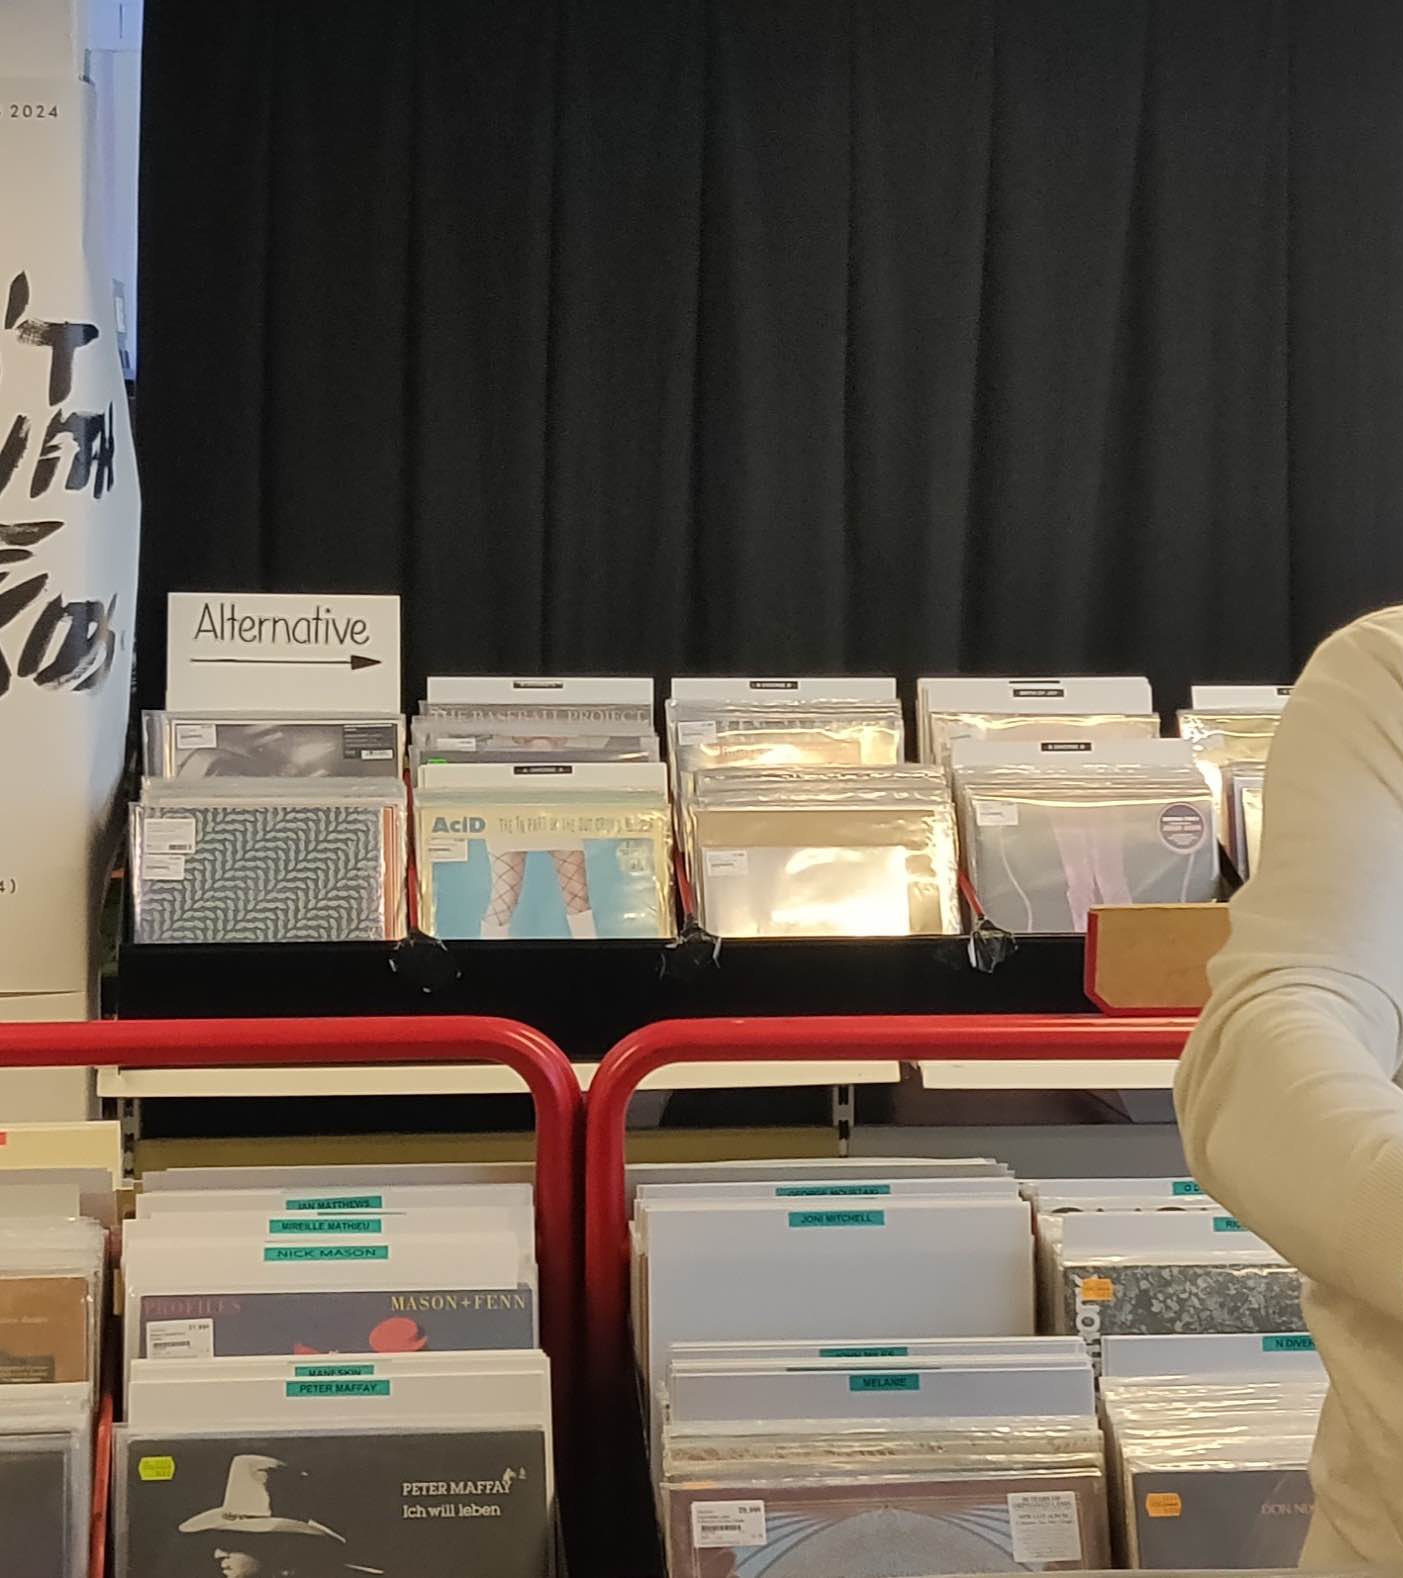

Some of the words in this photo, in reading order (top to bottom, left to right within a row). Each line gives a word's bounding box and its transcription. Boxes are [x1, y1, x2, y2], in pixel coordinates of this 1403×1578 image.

[10, 103, 59, 119] 2024
[193, 602, 371, 645] Alternative
[826, 1213, 873, 1223] MITCHELL
[281, 1222, 325, 1232] MIREILLE
[328, 1221, 370, 1231] MATHIEU
[277, 1250, 314, 1258] NICK
[319, 1249, 376, 1257] MASON
[299, 1383, 333, 1394] PETER
[335, 1382, 377, 1393] MAFFAY
[402, 1481, 448, 1497] PETER
[449, 1480, 512, 1495] MAFFAY
[402, 1503, 427, 1519] Ich
[428, 1503, 456, 1518] will
[457, 1503, 502, 1518] leben
